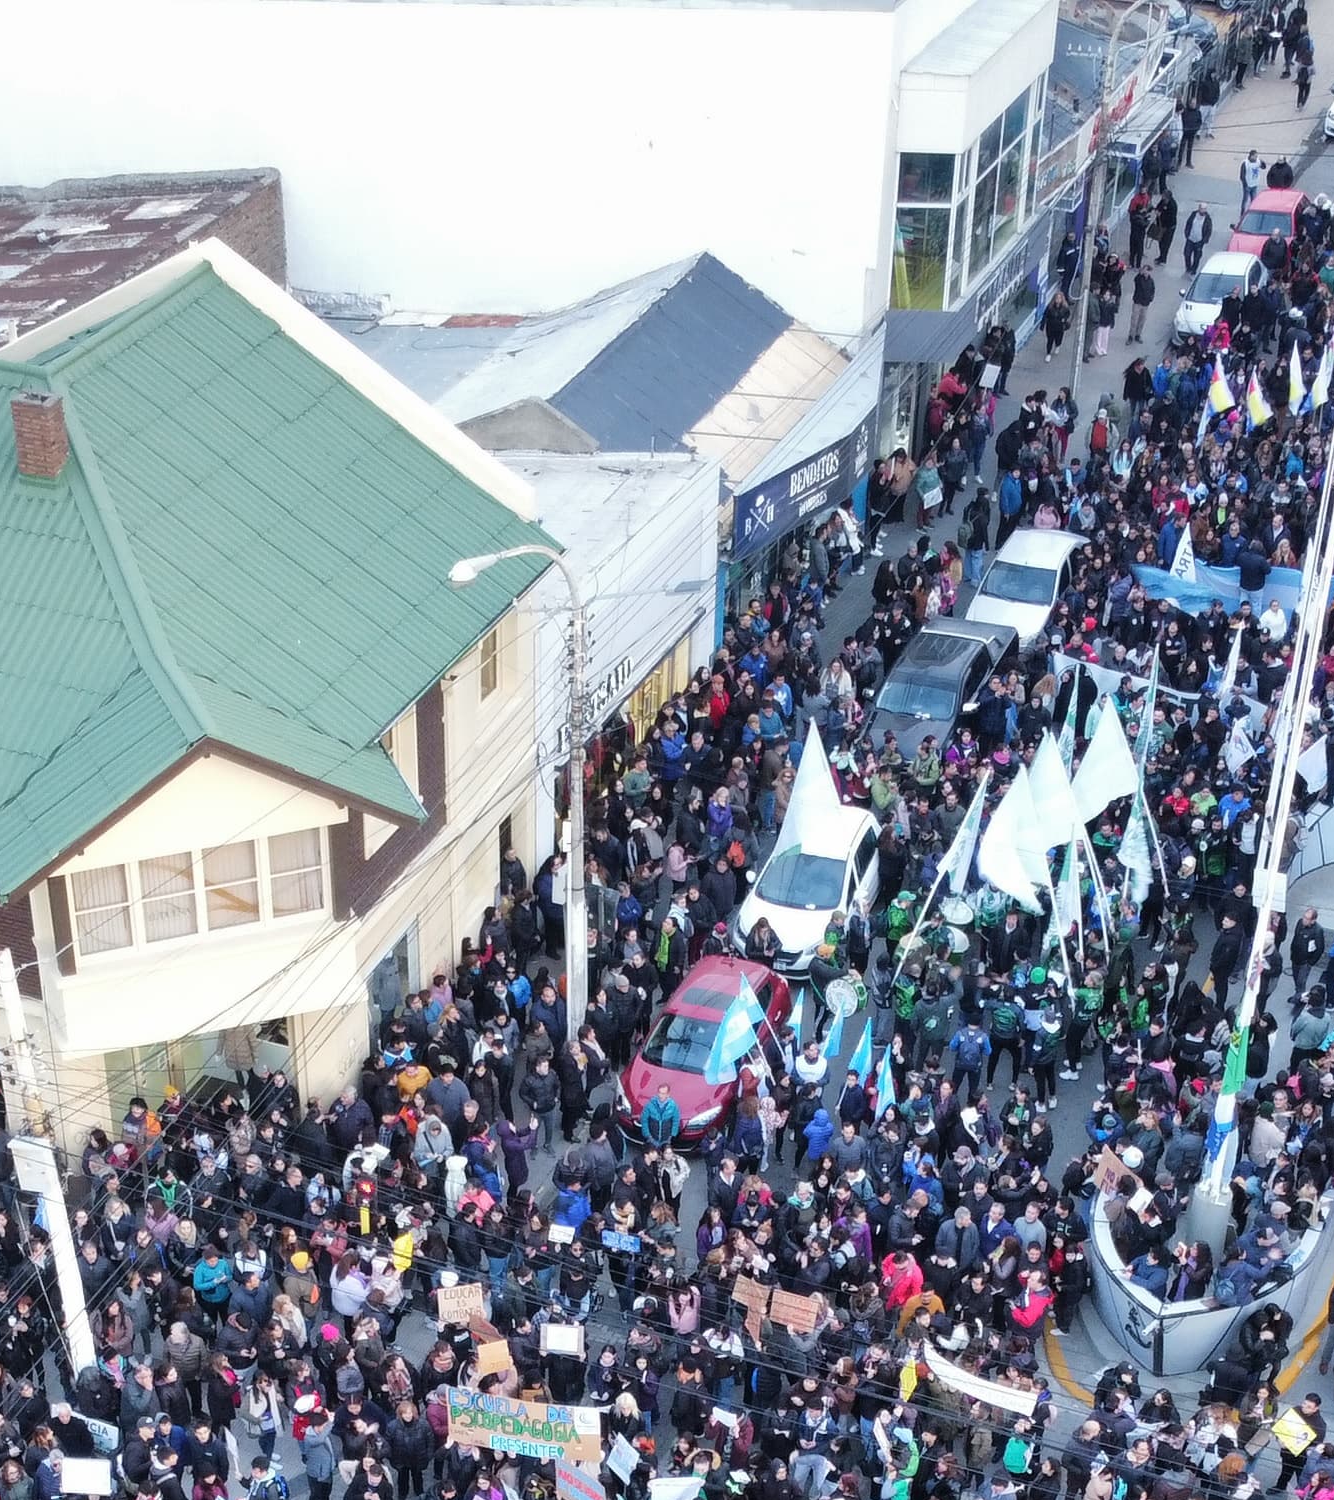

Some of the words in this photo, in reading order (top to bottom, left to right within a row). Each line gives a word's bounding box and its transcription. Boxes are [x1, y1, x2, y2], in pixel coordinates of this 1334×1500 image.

[789, 449, 839, 497] BENDITOS
[799, 490, 828, 517] HOMBRES
[444, 1287, 480, 1300] EDUCAR
[448, 1388, 529, 1419] ESCUELA
